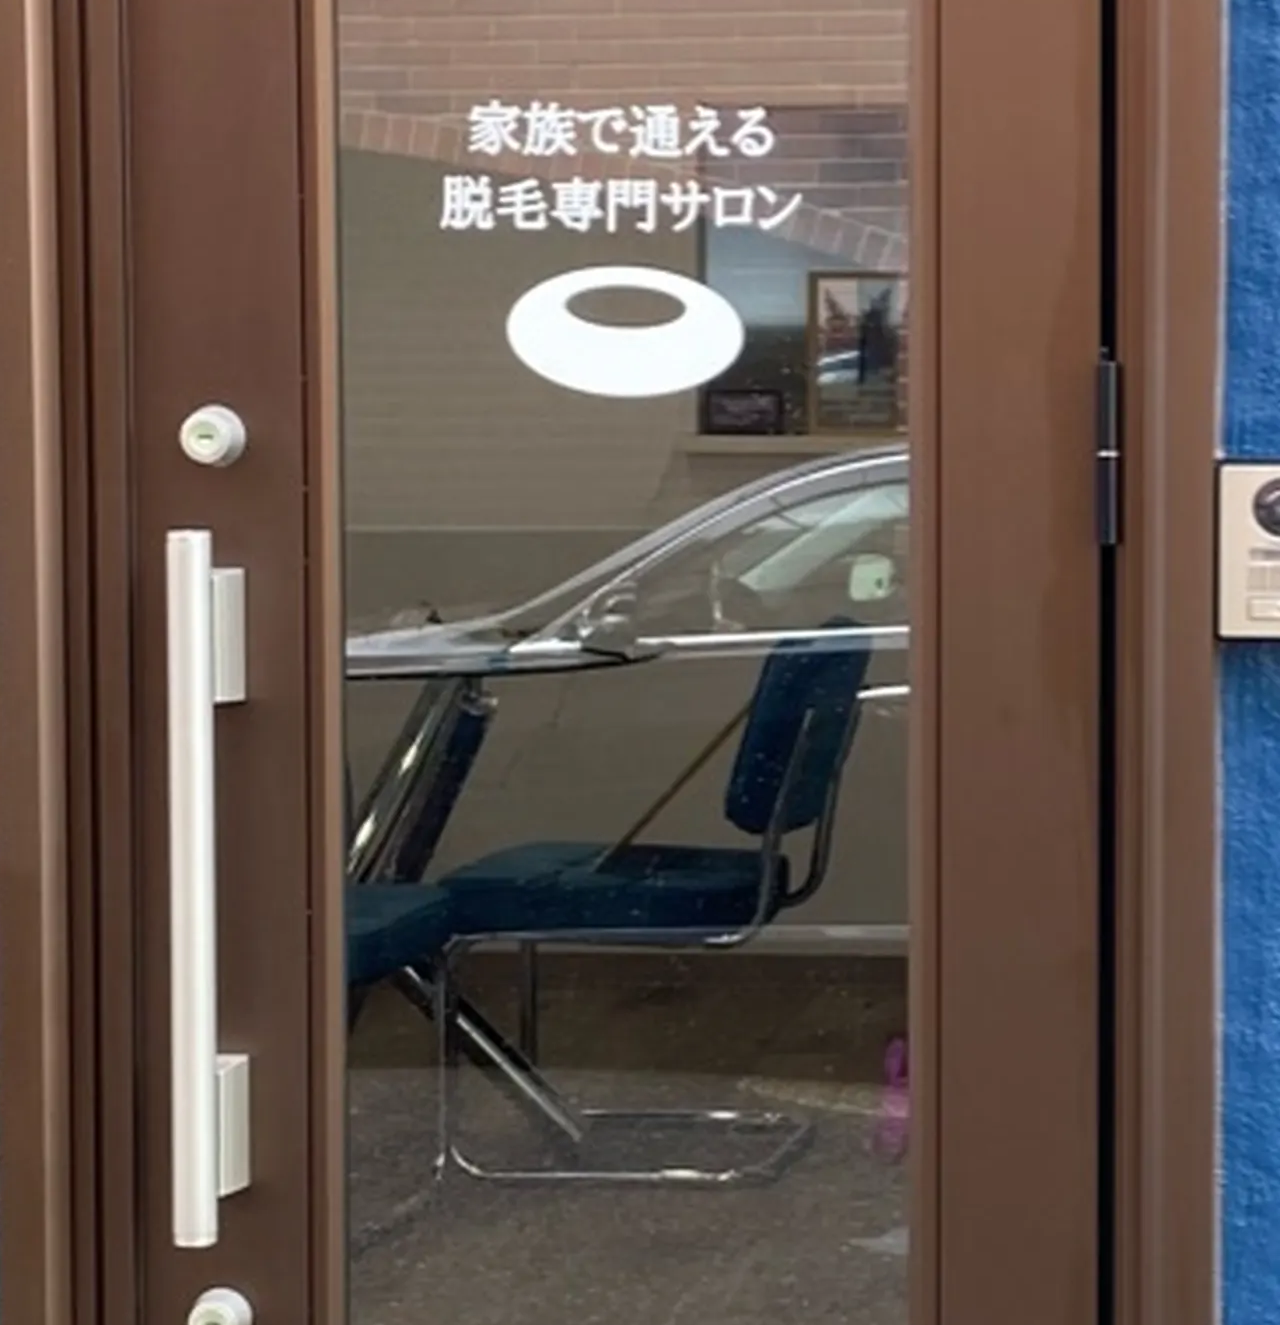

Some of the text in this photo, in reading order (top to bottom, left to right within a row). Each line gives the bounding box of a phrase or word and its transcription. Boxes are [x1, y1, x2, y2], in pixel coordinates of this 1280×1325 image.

[467, 98, 775, 159] 家族で通える
[439, 174, 803, 234] 脱毛専門サロン
